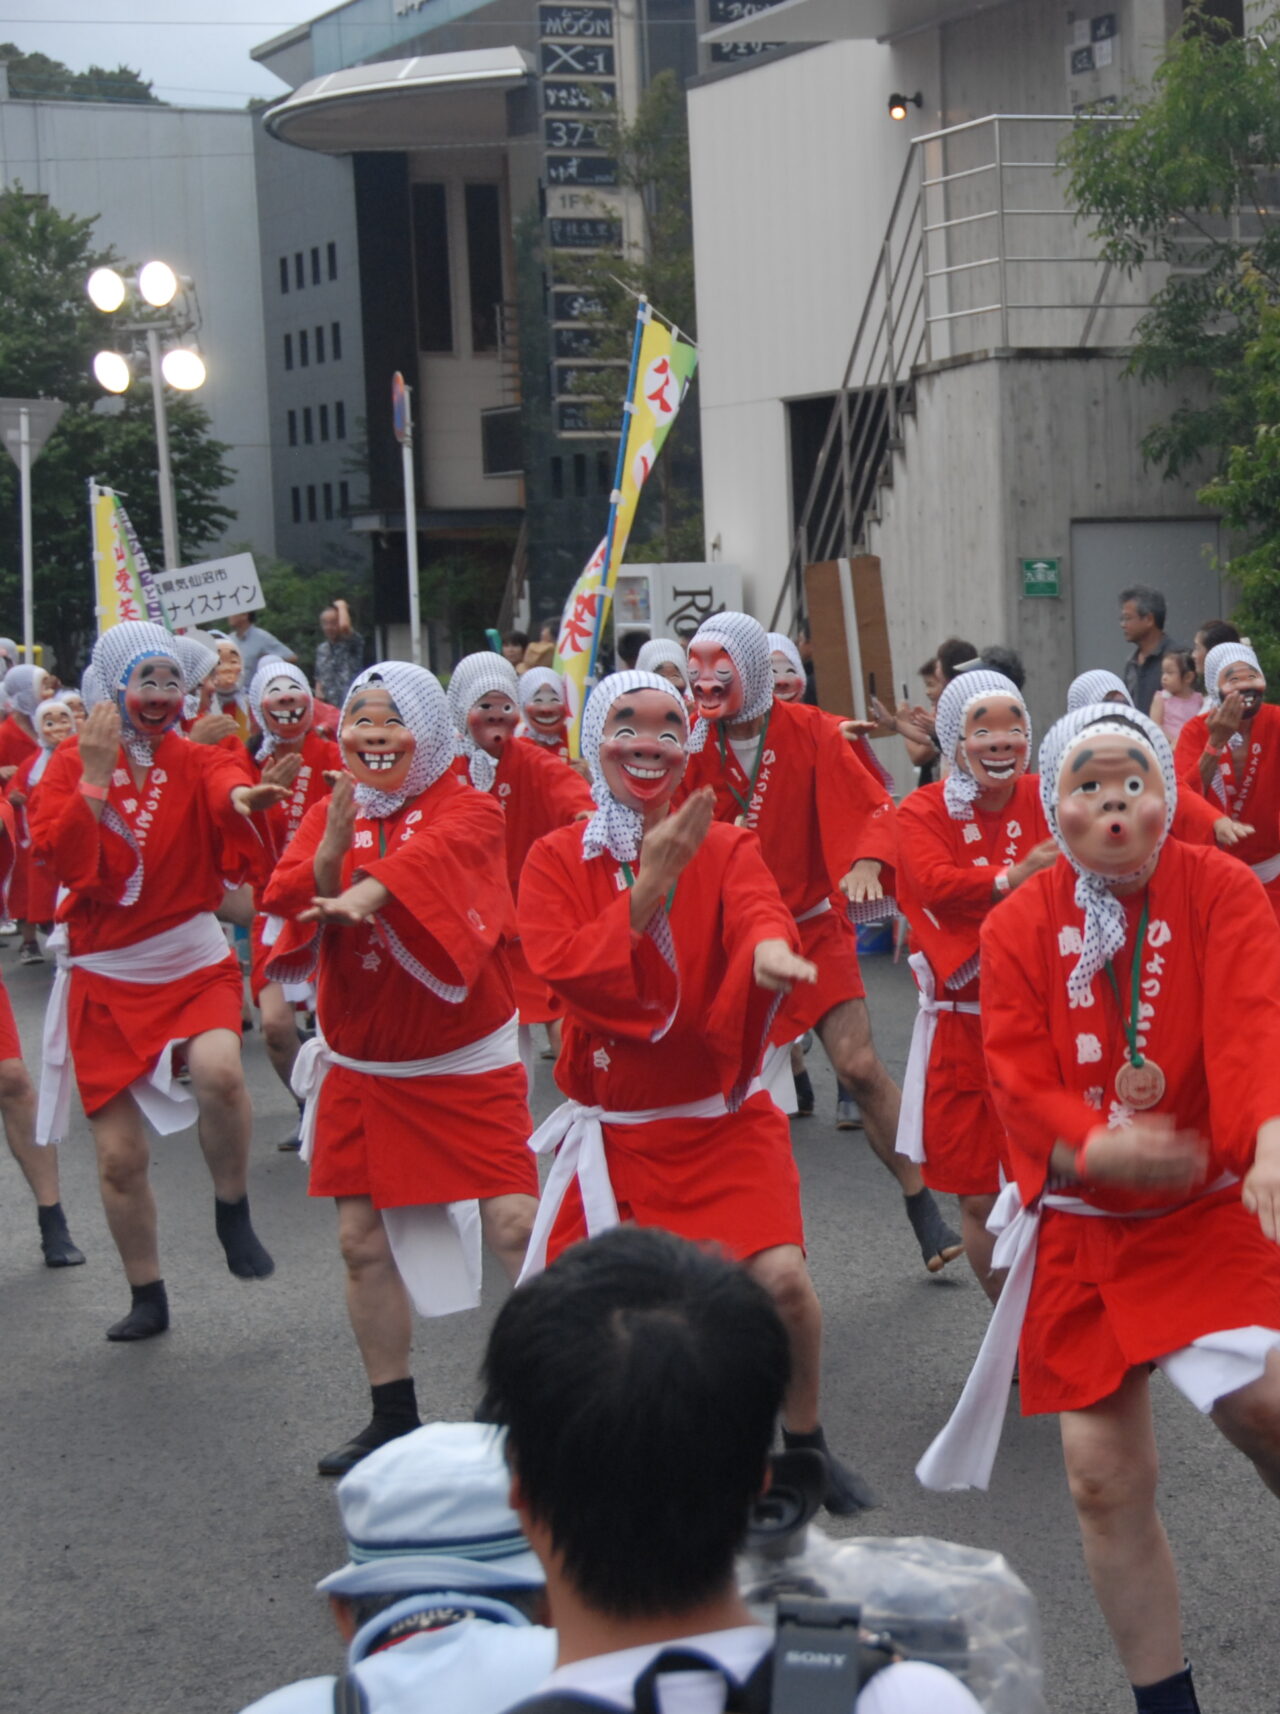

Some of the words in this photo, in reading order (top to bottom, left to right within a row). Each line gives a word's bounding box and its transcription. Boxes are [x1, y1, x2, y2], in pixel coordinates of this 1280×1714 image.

[546, 18, 610, 36] MOON
[167, 585, 256, 622] ナイスナイン
[785, 1651, 847, 1667] SONY
